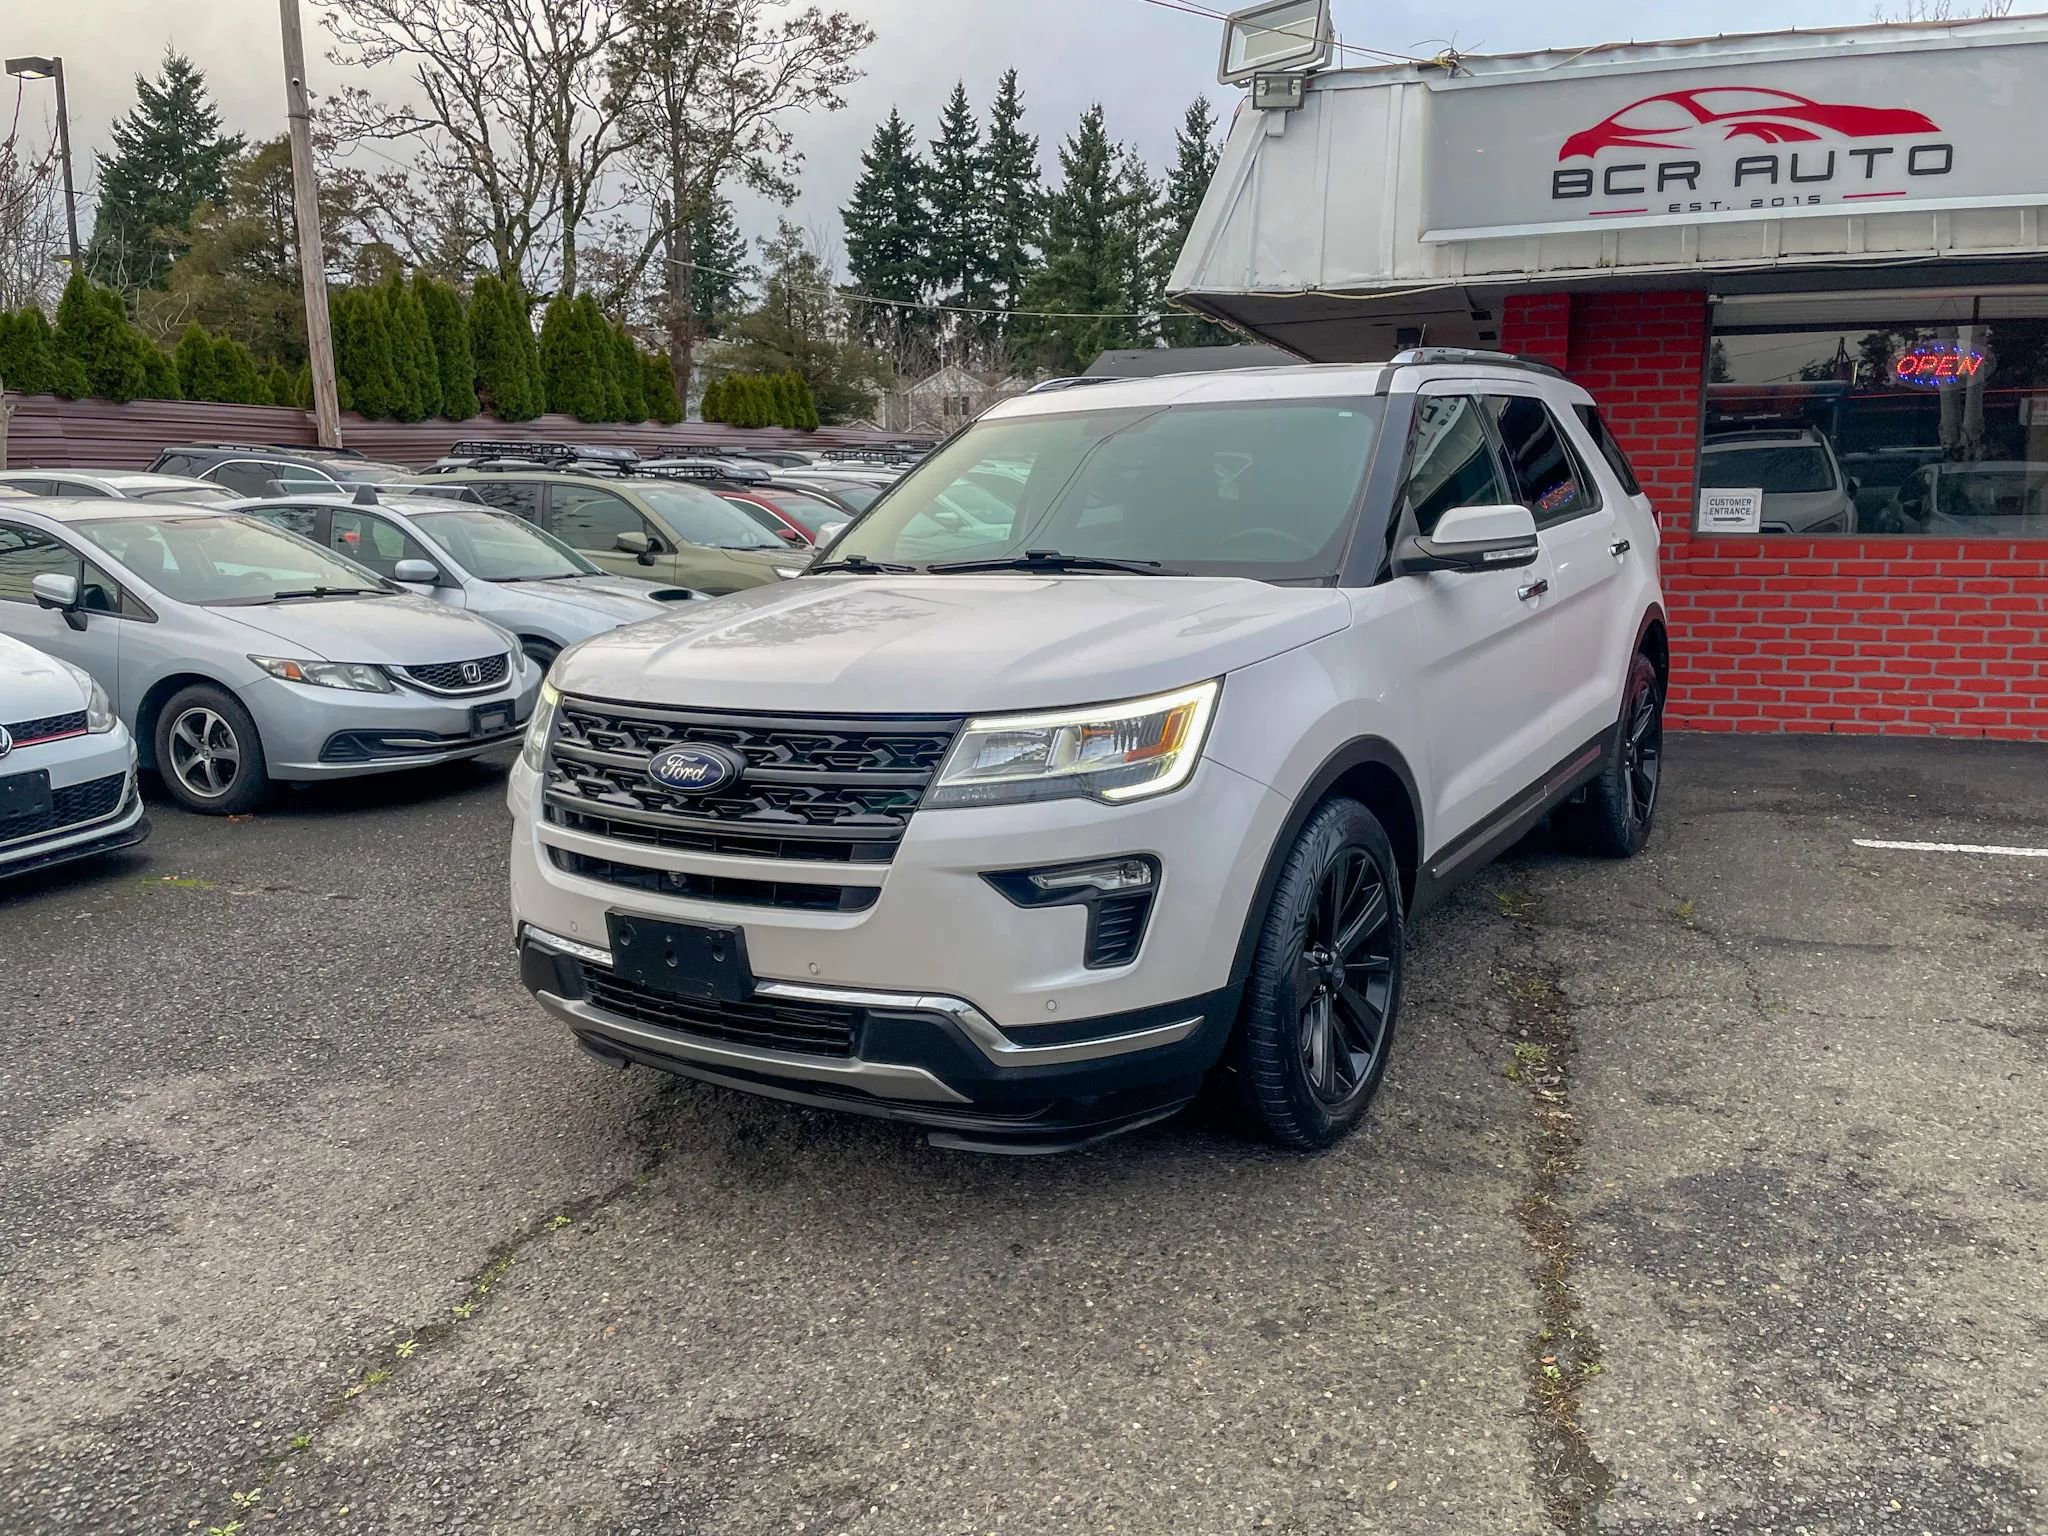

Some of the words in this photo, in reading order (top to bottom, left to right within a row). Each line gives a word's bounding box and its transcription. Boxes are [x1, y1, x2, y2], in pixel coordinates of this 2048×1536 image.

[1552, 160, 1701, 199] BCR
[1734, 143, 1953, 187] AUTO
[1669, 201, 1731, 212] EST.
[1750, 195, 1821, 208] 2015
[1896, 355, 1984, 375] OPEN
[1709, 498, 1752, 506] CUSTOMER
[1709, 507, 1751, 516] ENTRANCE
[661, 754, 709, 782] Ford
